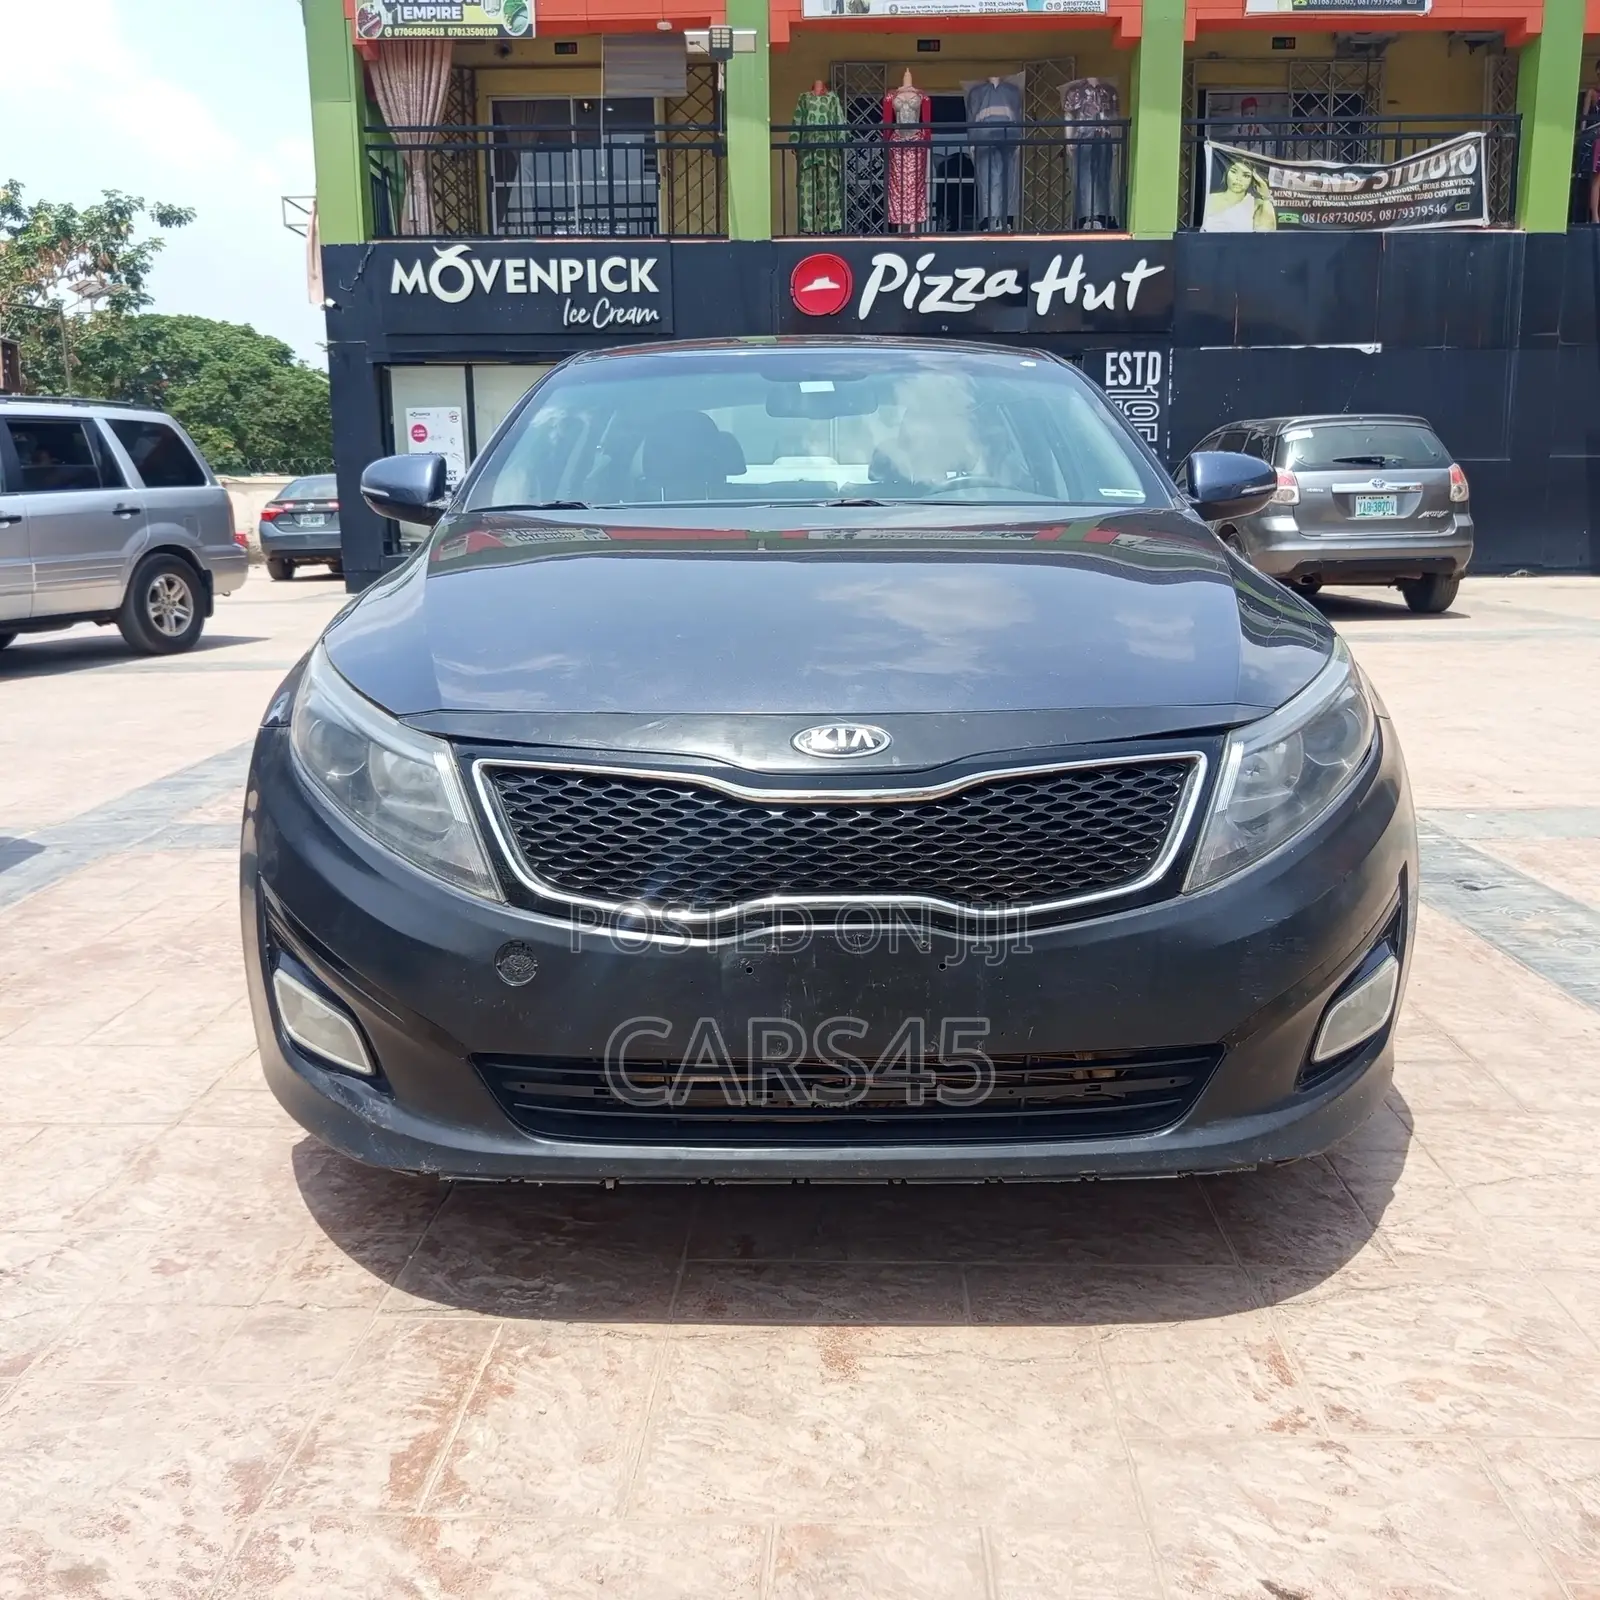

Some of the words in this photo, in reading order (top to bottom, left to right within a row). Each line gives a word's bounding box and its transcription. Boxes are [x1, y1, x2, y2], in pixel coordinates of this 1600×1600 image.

[403, 6, 462, 19] EMPIRE
[1434, 187, 1471, 199] COVERAGE
[1440, 178, 1475, 189] SERVICES,
[1302, 210, 1377, 224] 08168730505,
[1379, 203, 1448, 220] 08179379546
[858, 252, 1023, 321] Pizza
[1030, 253, 1165, 317] Hut
[563, 298, 590, 326] Ice
[592, 297, 660, 329] Cream
[1105, 351, 1162, 386] ESTD
[810, 728, 875, 749] KIA
